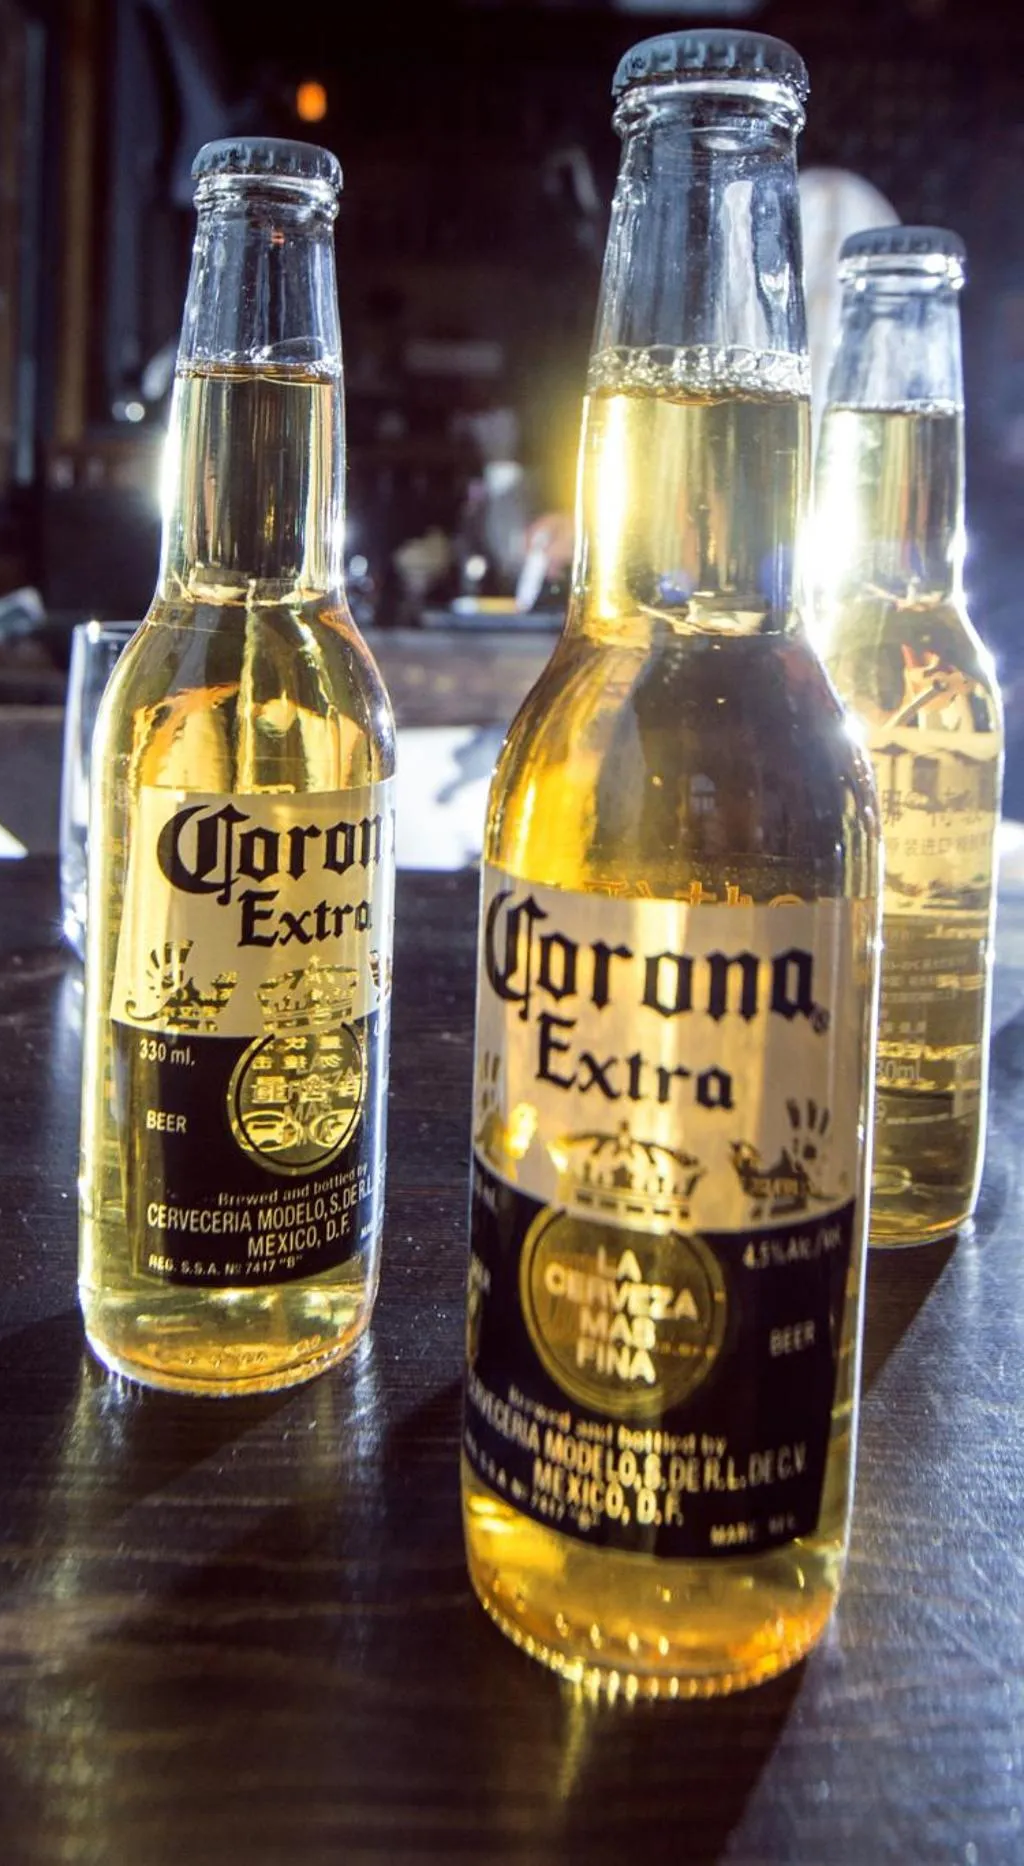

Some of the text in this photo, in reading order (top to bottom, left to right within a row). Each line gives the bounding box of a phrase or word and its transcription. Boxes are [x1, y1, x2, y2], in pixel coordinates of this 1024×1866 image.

[237, 888, 373, 948] Extra
[485, 889, 816, 1023] Corona
[139, 1038, 196, 1067] 330 ml.
[536, 1011, 736, 1111] Extra
[145, 1108, 187, 1134] BEER
[146, 1201, 253, 1235] CERVECERIA
[257, 1196, 328, 1232] MODELO,
[247, 1224, 322, 1259] MEXICO,
[326, 1211, 351, 1242] D.F.
[596, 1245, 643, 1283] LA
[576, 1337, 657, 1385] FINA
